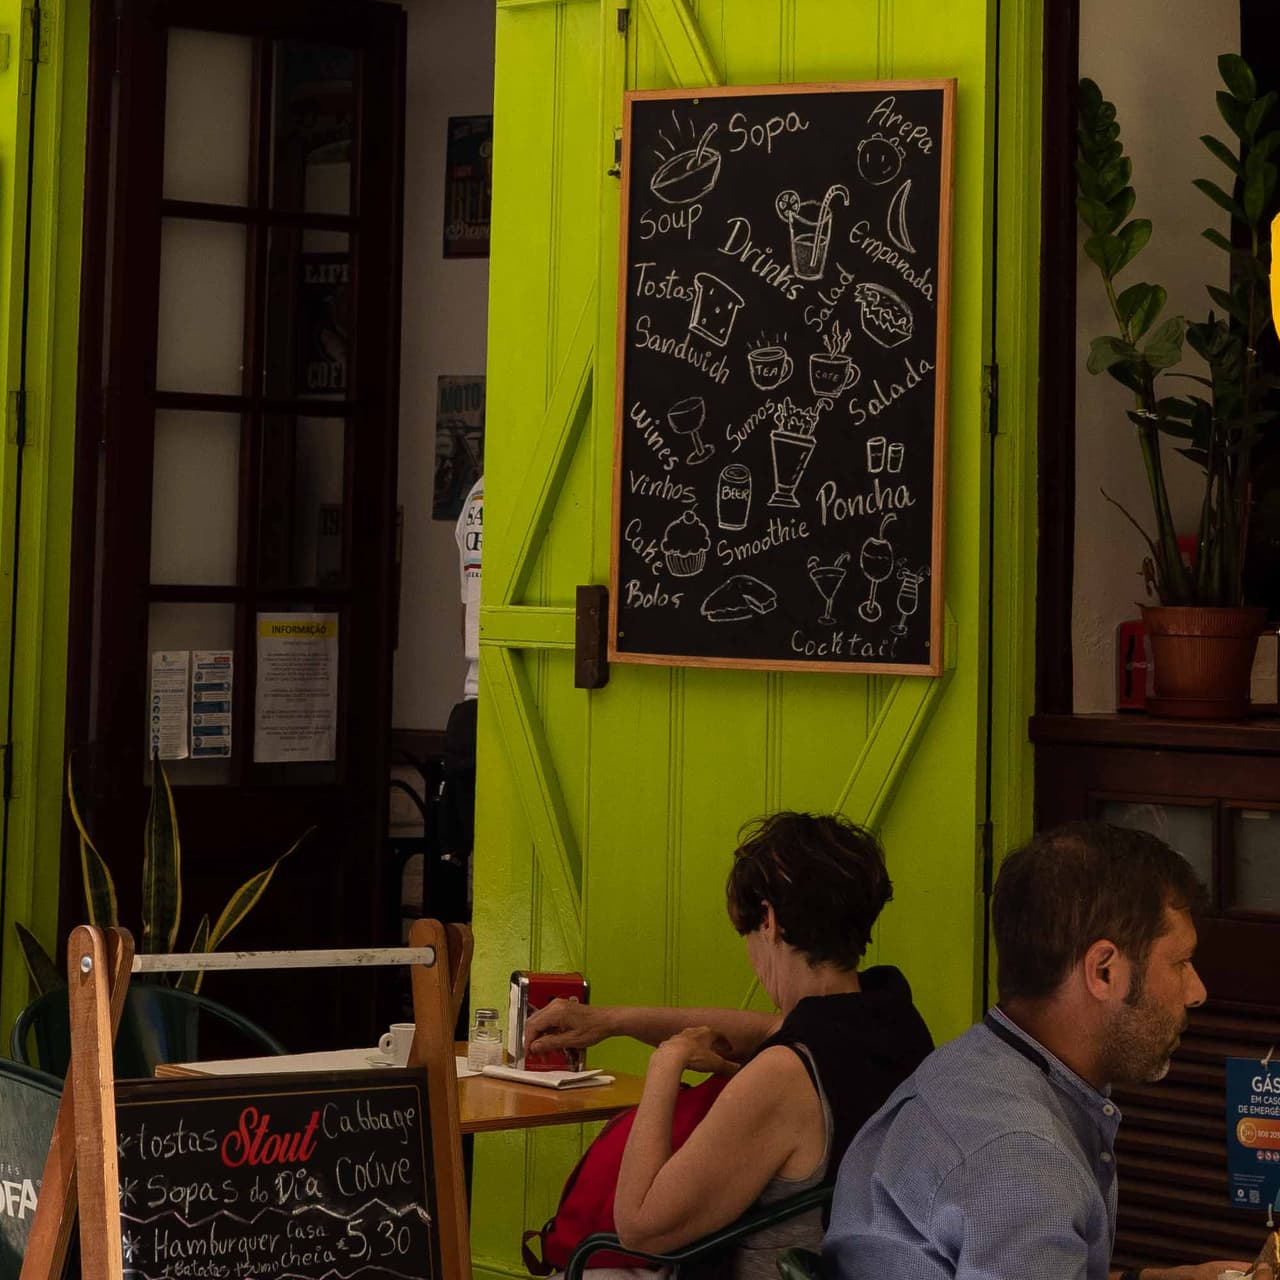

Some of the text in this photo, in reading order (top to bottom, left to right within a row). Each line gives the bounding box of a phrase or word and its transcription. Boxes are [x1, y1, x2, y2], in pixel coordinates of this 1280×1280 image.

[729, 107, 810, 154] Sopa
[867, 95, 935, 155] Arepa
[639, 203, 702, 240] Soup
[634, 261, 695, 302] Tostas
[718, 217, 804, 301] Drinks
[849, 220, 936, 304] Empanada
[804, 261, 856, 332] Salad
[634, 316, 730, 385] Sandwich
[754, 364, 779, 379] TEA
[848, 358, 935, 426] Salada
[726, 399, 775, 454] Sumos
[629, 469, 697, 504] Vinhos
[721, 484, 749, 501] BEER
[816, 479, 916, 525] Poncha
[625, 520, 663, 576] Cake
[717, 520, 810, 566] Smoothie
[626, 580, 684, 609] Bolos
[272, 624, 327, 637] INFORMAÇÃO
[791, 630, 899, 658] Cocktail
[322, 1099, 416, 1145] Cabbage
[1238, 1105, 1249, 1114] DE
[1251, 1095, 1263, 1104] EM
[221, 1106, 321, 1168] Stout
[147, 1174, 239, 1219] Sopas
[250, 1175, 269, 1204] do
[154, 1222, 281, 1264] Hamburguer
